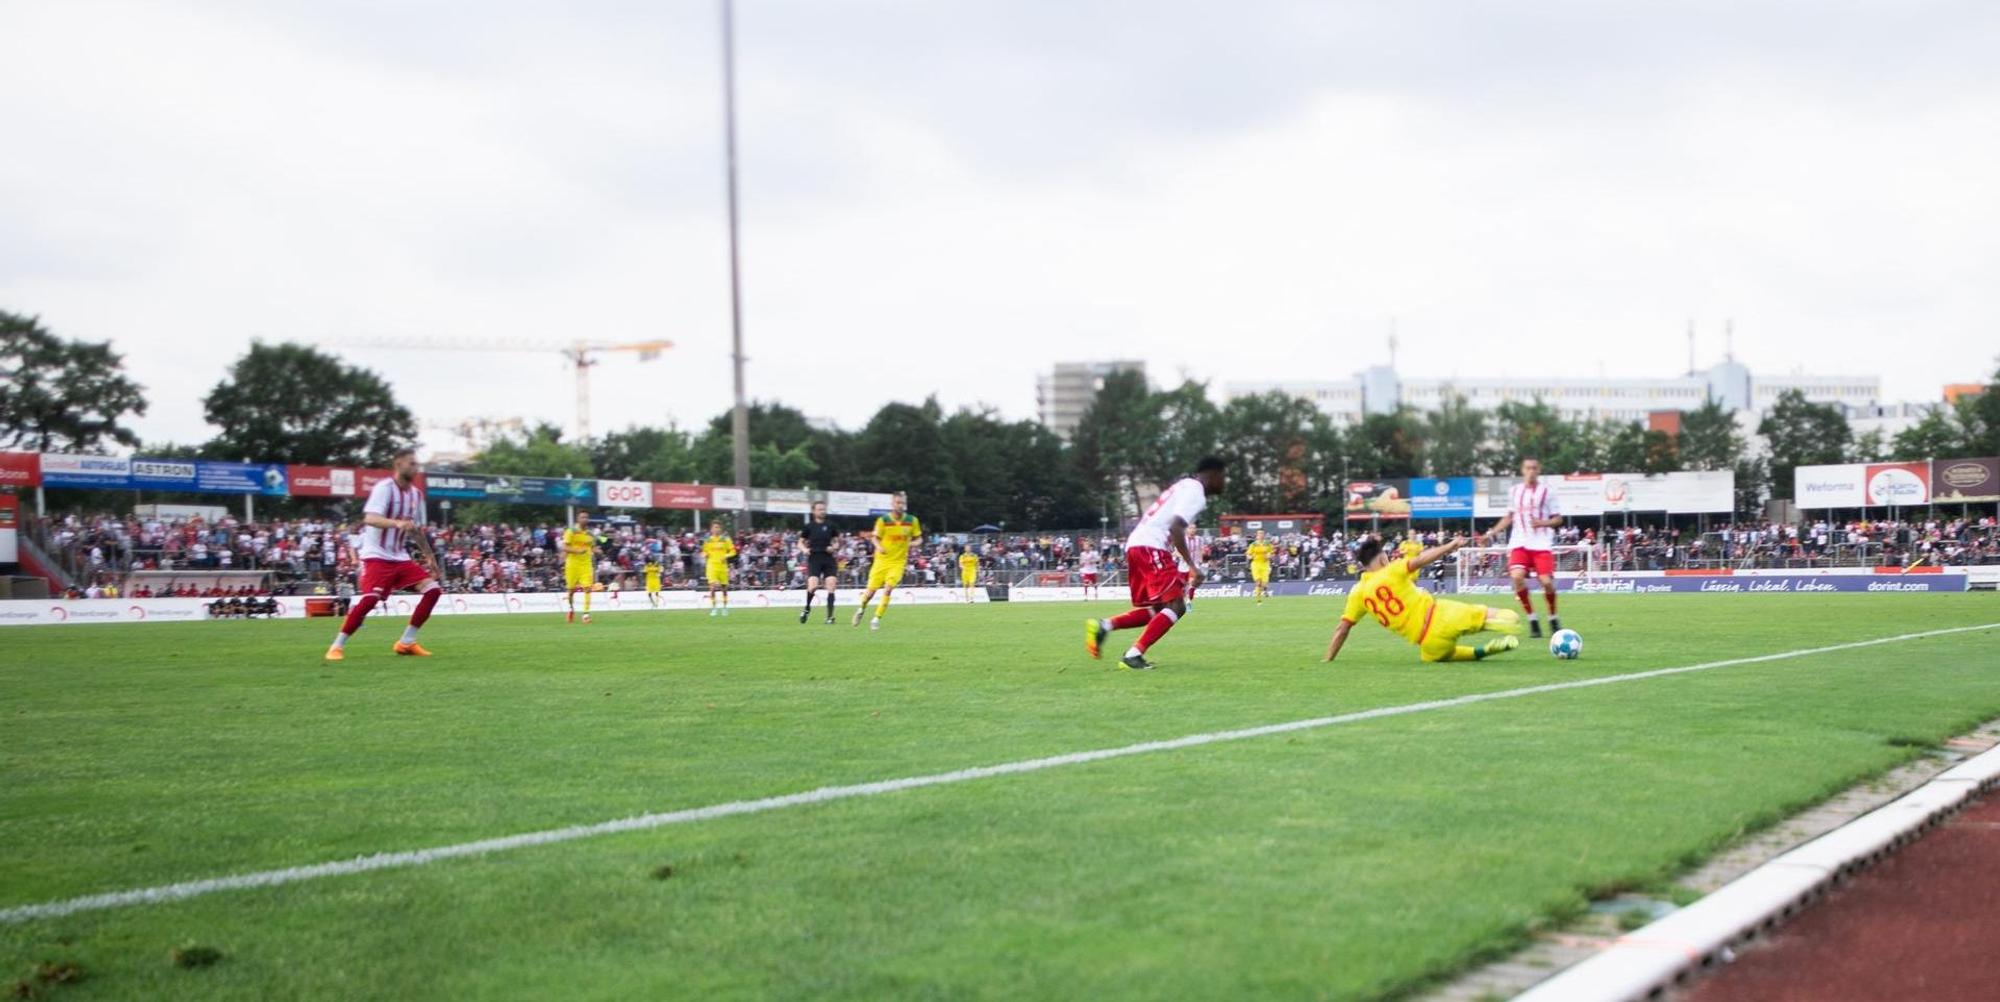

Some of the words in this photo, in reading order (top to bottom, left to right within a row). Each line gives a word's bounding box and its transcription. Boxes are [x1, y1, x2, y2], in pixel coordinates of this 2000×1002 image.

[135, 463, 193, 475] ASTRON
[1806, 482, 1855, 492] Weforma
[1194, 585, 1242, 597] ssential
[1572, 579, 1635, 592] Essential
[1867, 581, 1929, 592] dorint.com
[1364, 585, 1405, 628] 38
